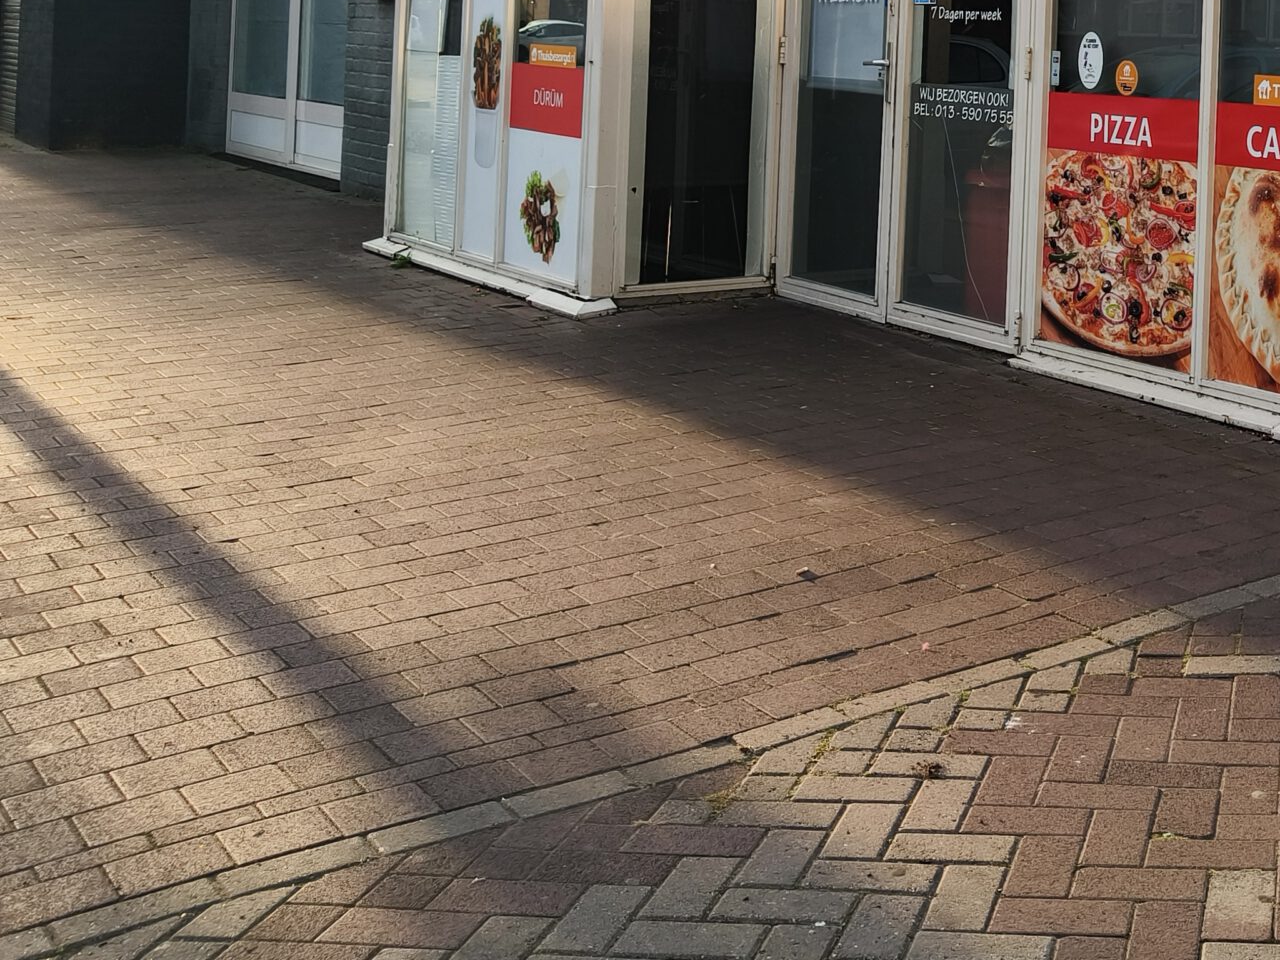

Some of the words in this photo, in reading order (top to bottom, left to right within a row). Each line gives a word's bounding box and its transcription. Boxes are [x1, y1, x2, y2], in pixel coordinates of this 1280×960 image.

[931, 6, 938, 20] 7
[938, 6, 964, 23] Dagen
[965, 10, 980, 25] per
[981, 7, 1002, 21] week
[533, 87, 564, 108] DÜRÜM
[920, 87, 935, 100] WIJ
[936, 88, 985, 105] BEZORGEN
[986, 92, 1009, 107] OOK!
[961, 106, 983, 121] 590
[1090, 113, 1153, 148] PIZZA
